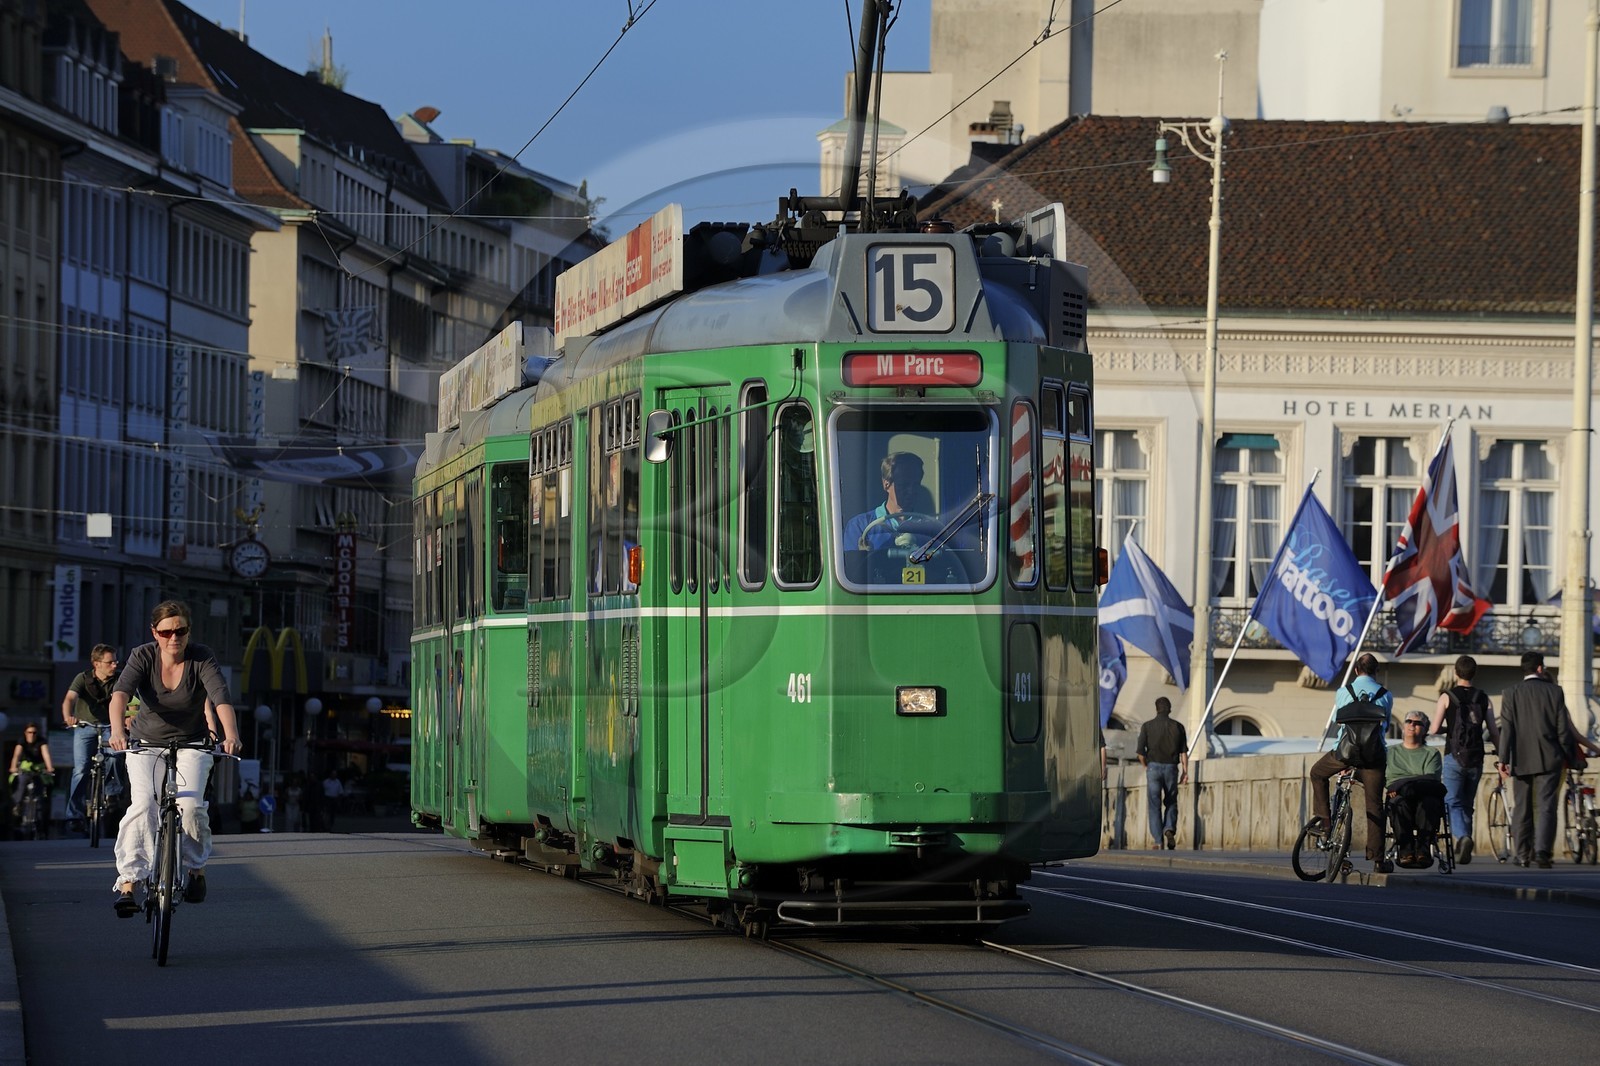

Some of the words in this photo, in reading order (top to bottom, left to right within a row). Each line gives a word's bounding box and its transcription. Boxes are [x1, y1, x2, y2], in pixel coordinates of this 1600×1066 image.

[874, 253, 944, 322] 15
[877, 354, 894, 376] M
[904, 354, 944, 376] Parc
[1283, 400, 1374, 418] HOTEL
[1389, 403, 1493, 420] MERIAN
[906, 570, 922, 584] 21
[786, 672, 812, 704] 461
[1013, 672, 1032, 703] 461
